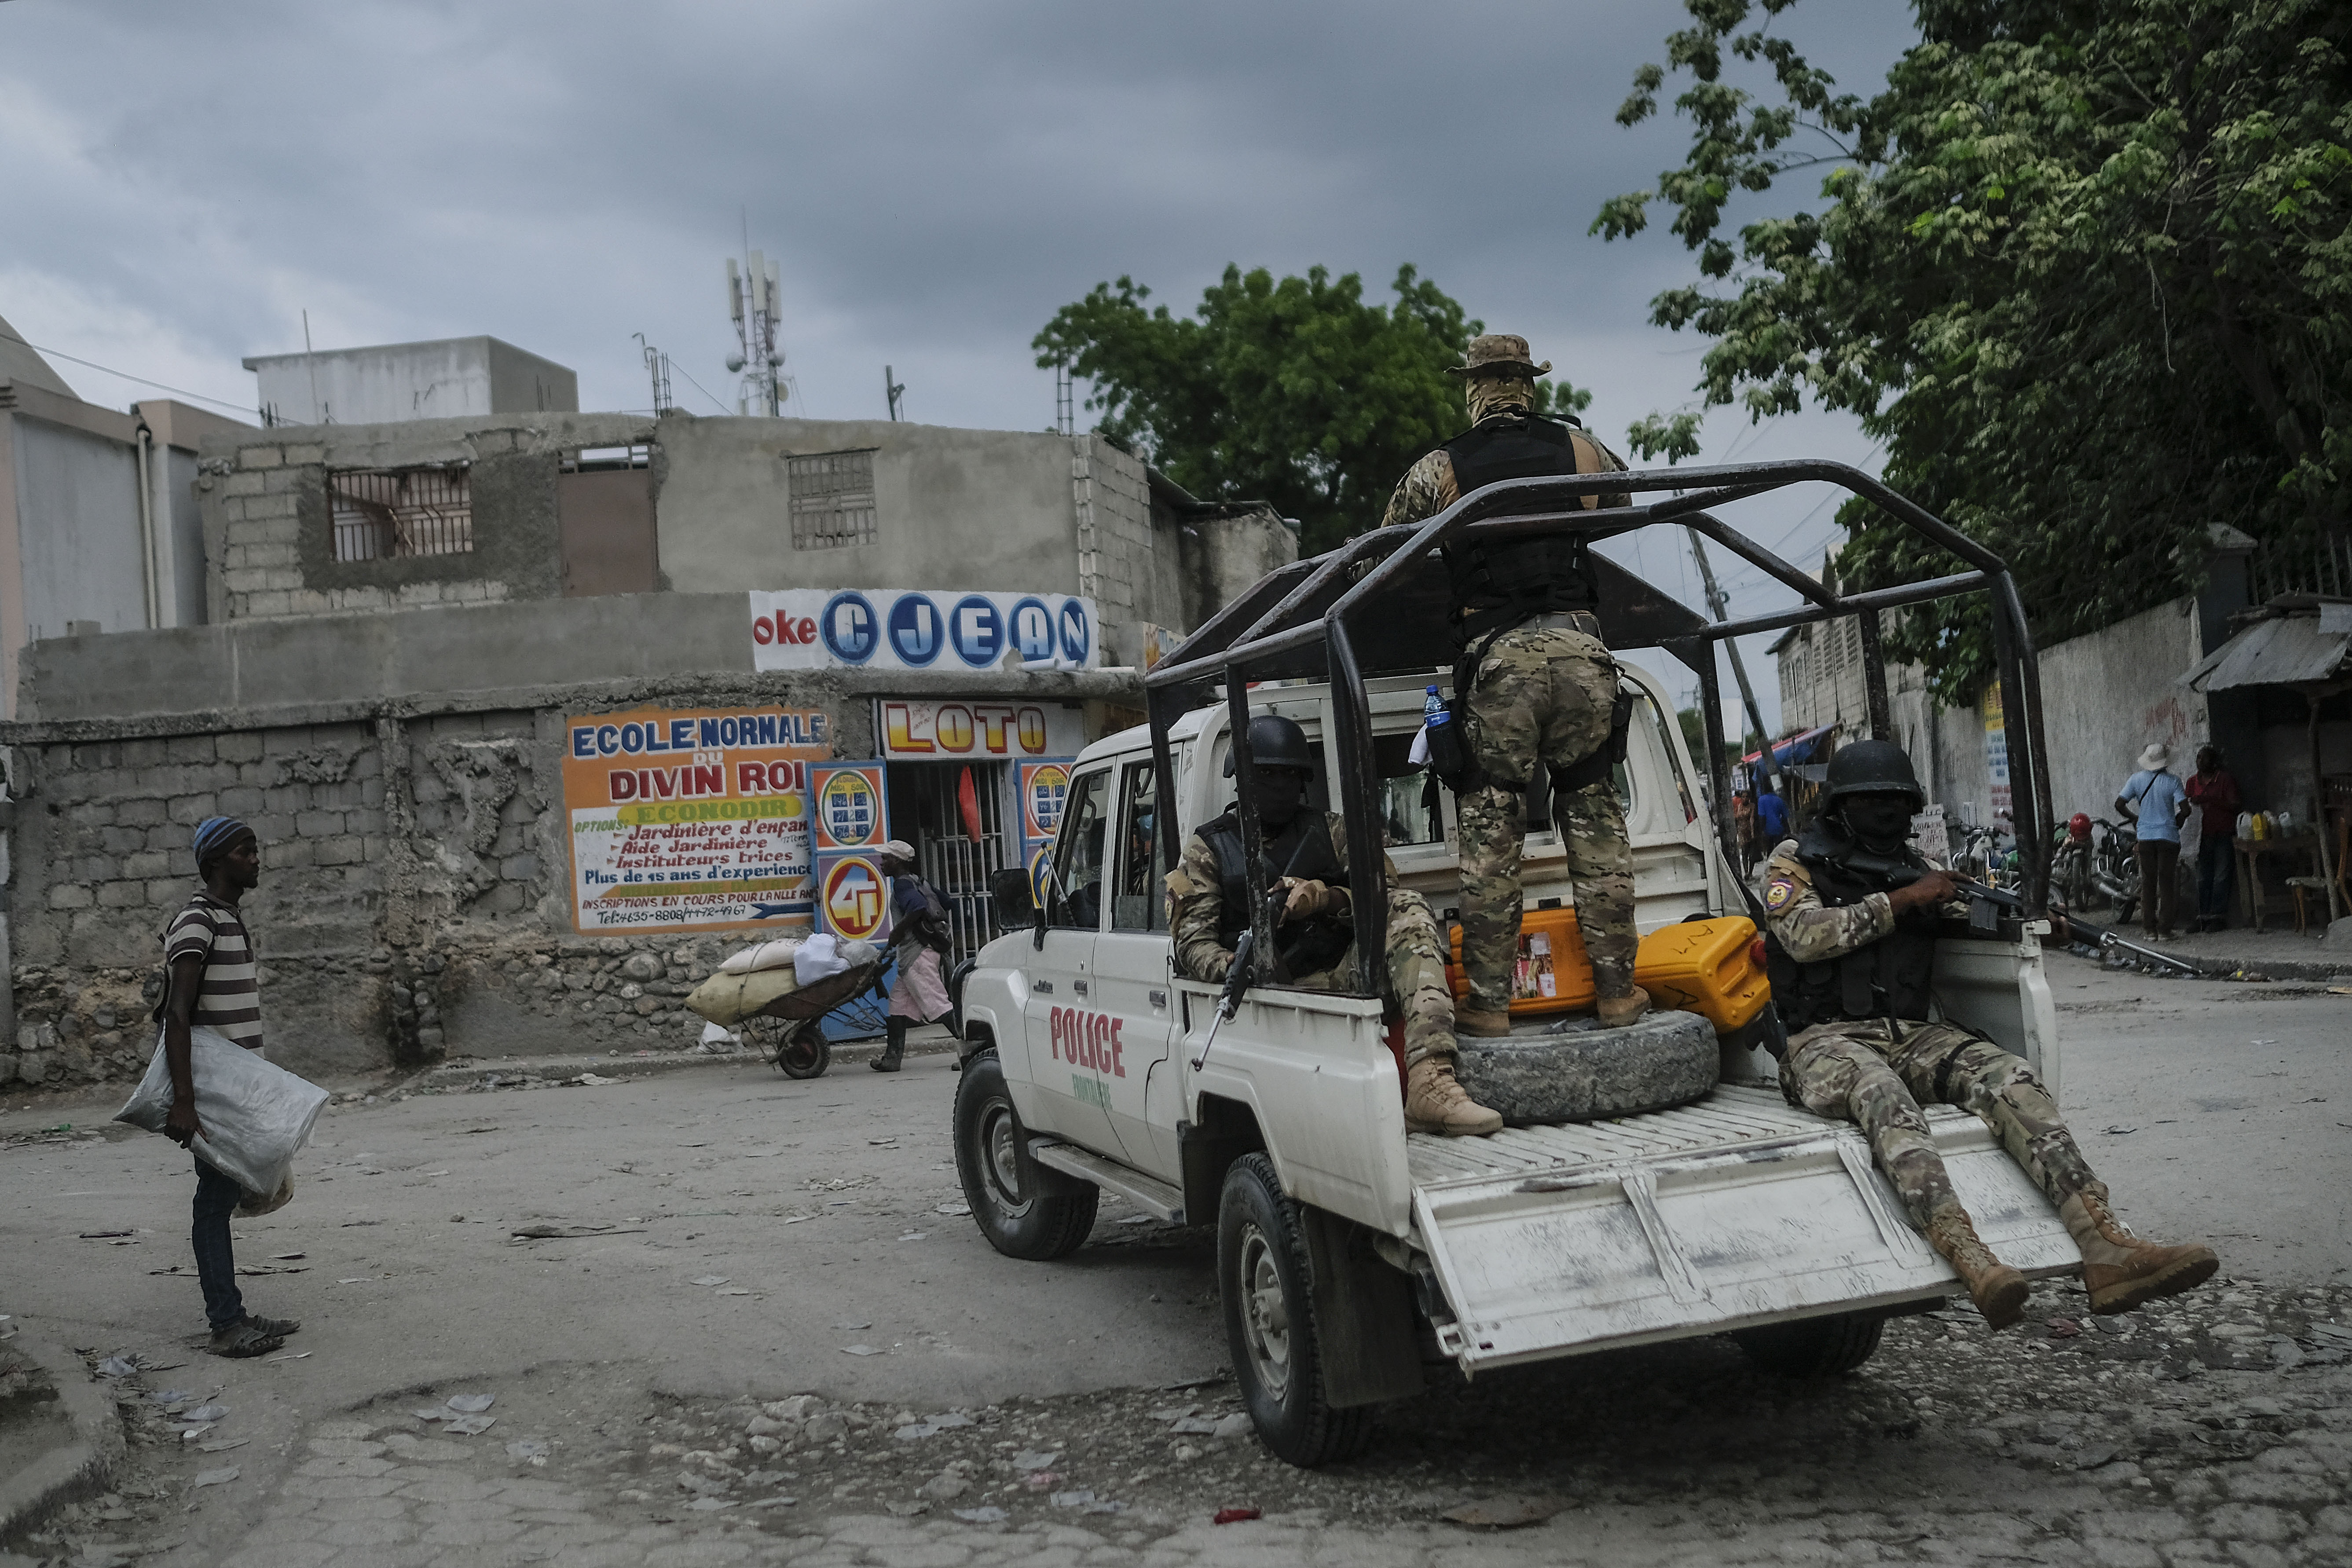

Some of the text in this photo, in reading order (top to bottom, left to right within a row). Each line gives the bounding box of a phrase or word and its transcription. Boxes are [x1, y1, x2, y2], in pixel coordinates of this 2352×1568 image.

[754, 609, 817, 645] oke
[573, 714, 826, 758] ECOLE NORMALE
[886, 704, 1047, 754] LOTO
[693, 752, 723, 765] DU
[610, 761, 805, 801] DIVIN ROI
[637, 799, 787, 823] ECONODIR
[849, 810, 855, 822] 2
[574, 819, 630, 833] OPTIONS:
[629, 821, 733, 840] Jardinière
[621, 836, 768, 854] Aide Jardinière
[616, 849, 793, 868] Instituteurs trices
[585, 869, 618, 884] Plus
[623, 868, 643, 882] de
[648, 872, 665, 882] 15
[670, 870, 702, 880] ans
[583, 897, 658, 909] INSCRIPTIONS
[662, 896, 679, 906] EN
[684, 893, 725, 905] COURS
[1050, 1005, 1126, 1078] POLICE
